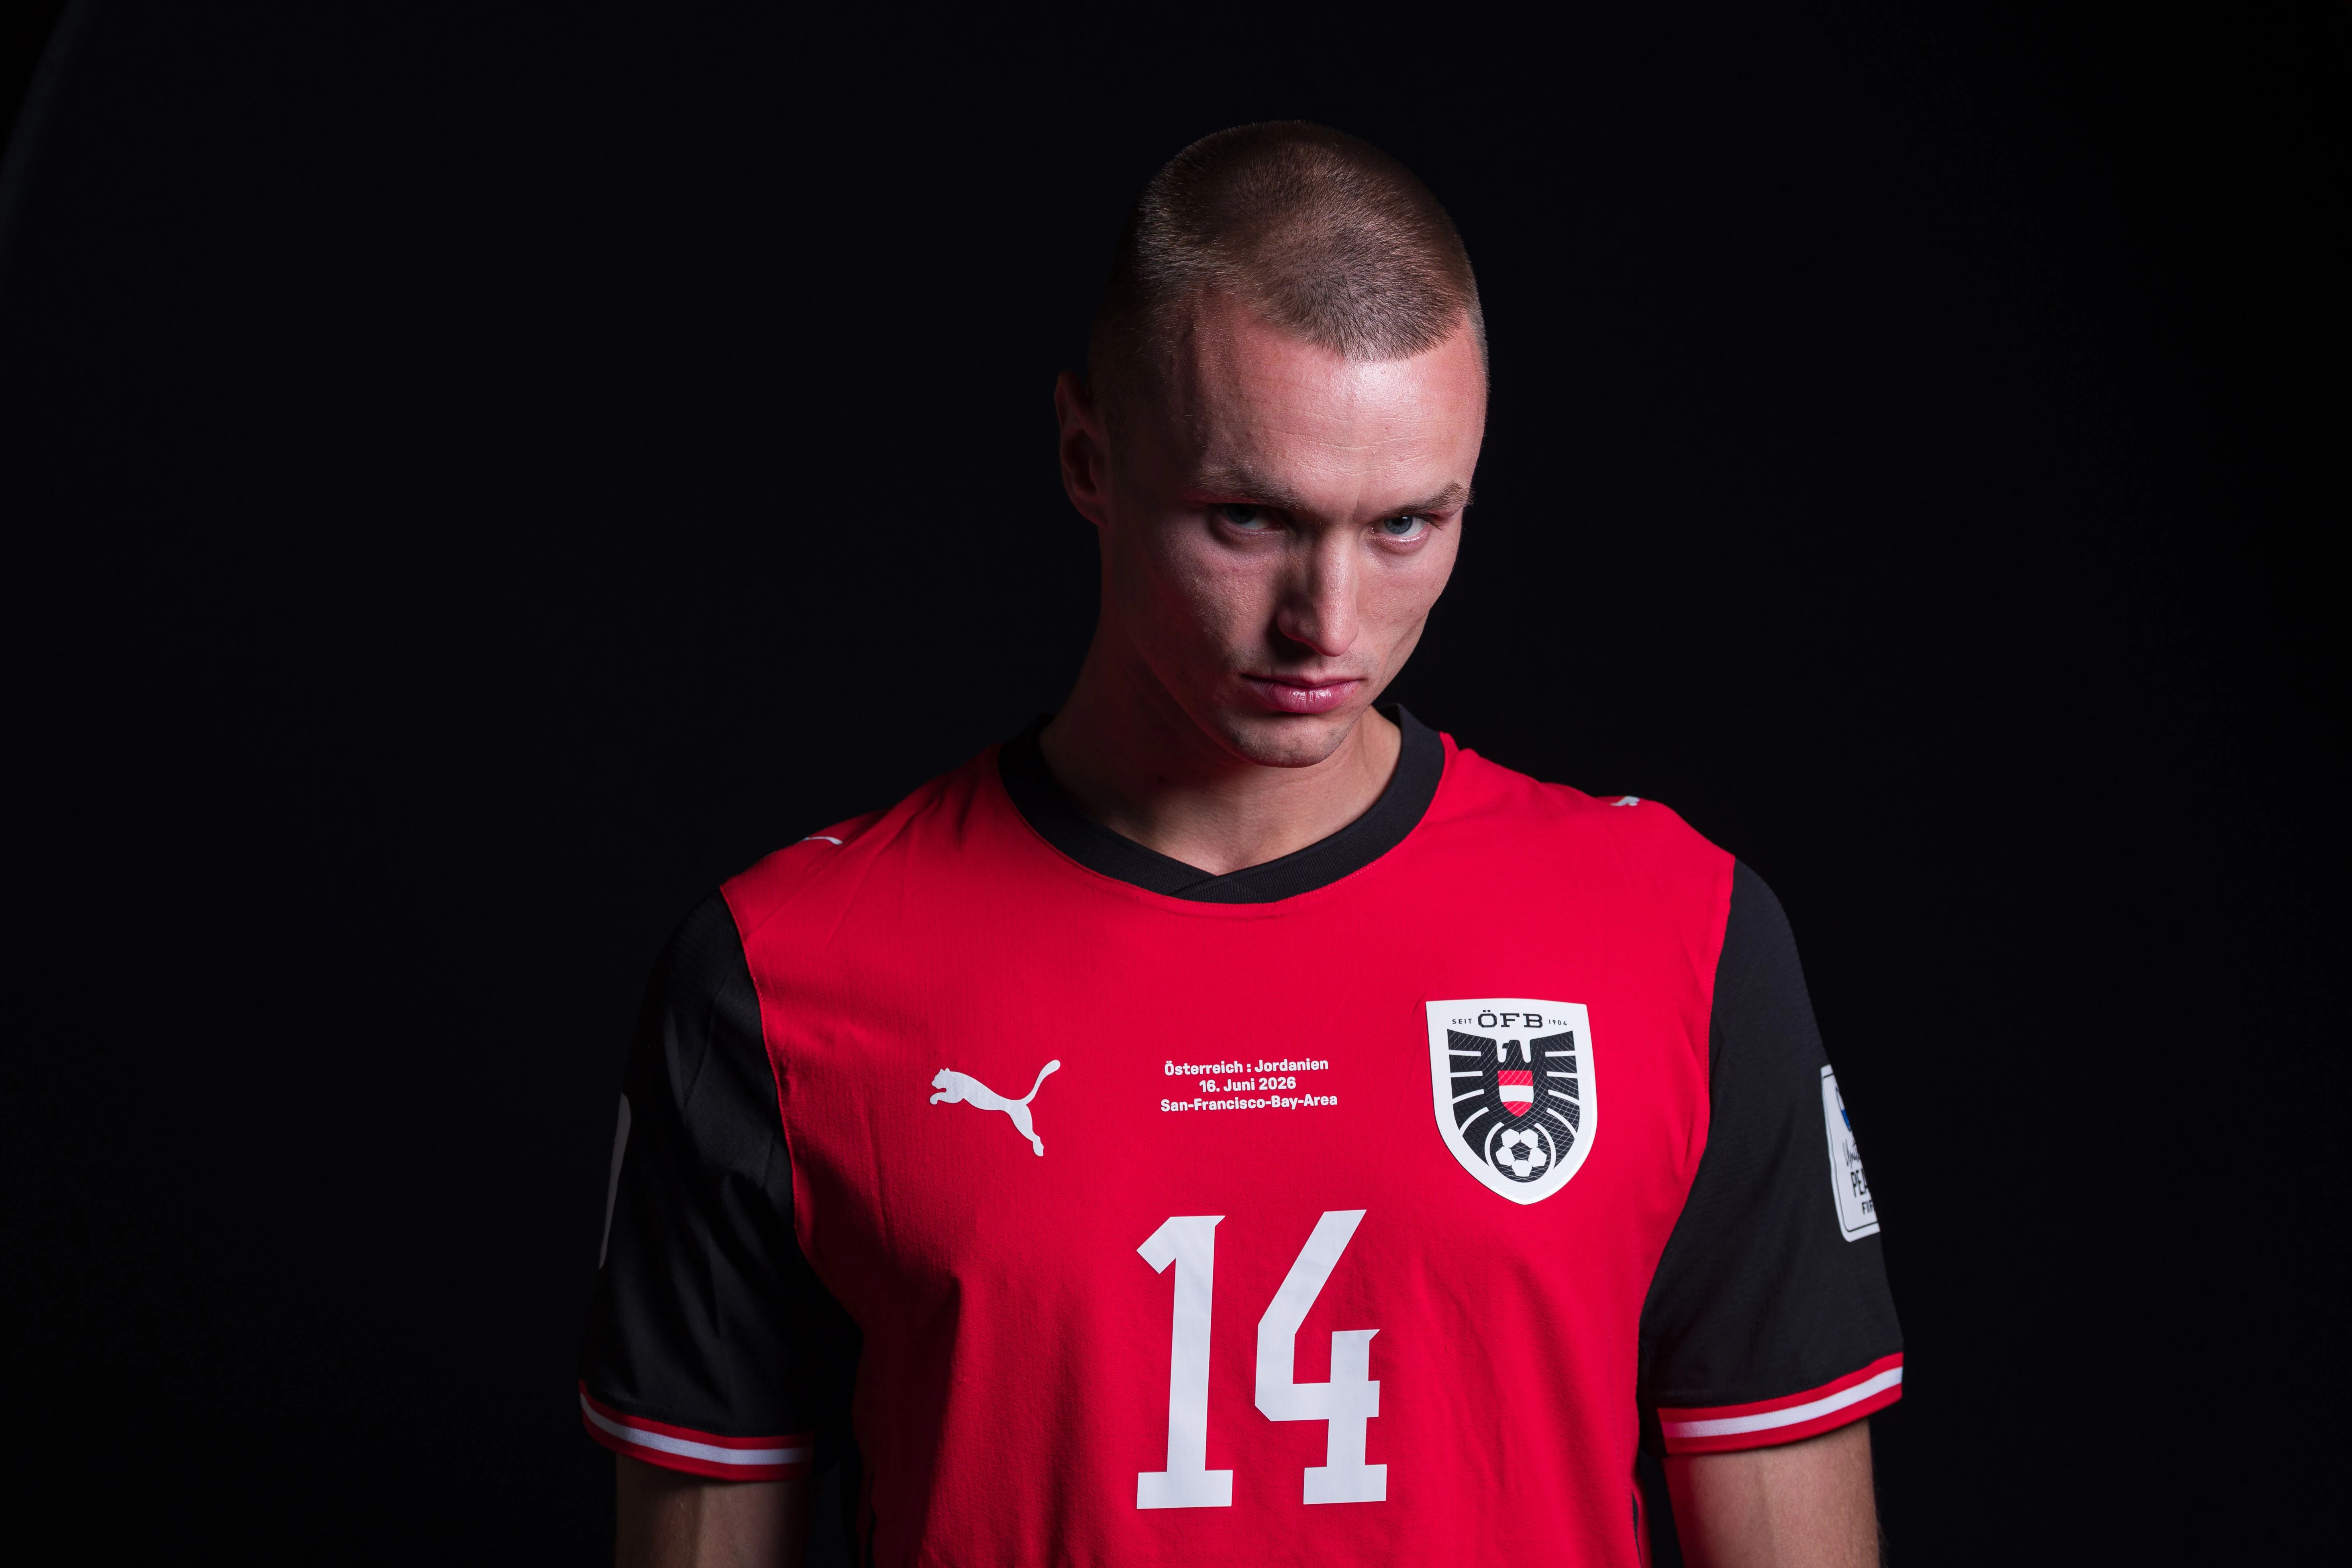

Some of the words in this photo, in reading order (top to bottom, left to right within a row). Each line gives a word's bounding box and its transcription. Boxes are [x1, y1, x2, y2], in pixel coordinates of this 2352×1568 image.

[1477, 1009, 1543, 1028] ÖFB
[1164, 1060, 1243, 1076] Österreich
[1246, 1063, 1251, 1073] :
[1254, 1058, 1329, 1073] Jordanien
[1199, 1079, 1220, 1093] 16.
[1223, 1077, 1255, 1092] Juni
[1259, 1076, 1297, 1090] 2026
[1161, 1093, 1338, 1112] San-Francisco-Bay-Area
[1850, 1168, 1869, 1197] PEA
[1862, 1200, 1874, 1215] FIF
[1136, 1209, 1387, 1509] 14
